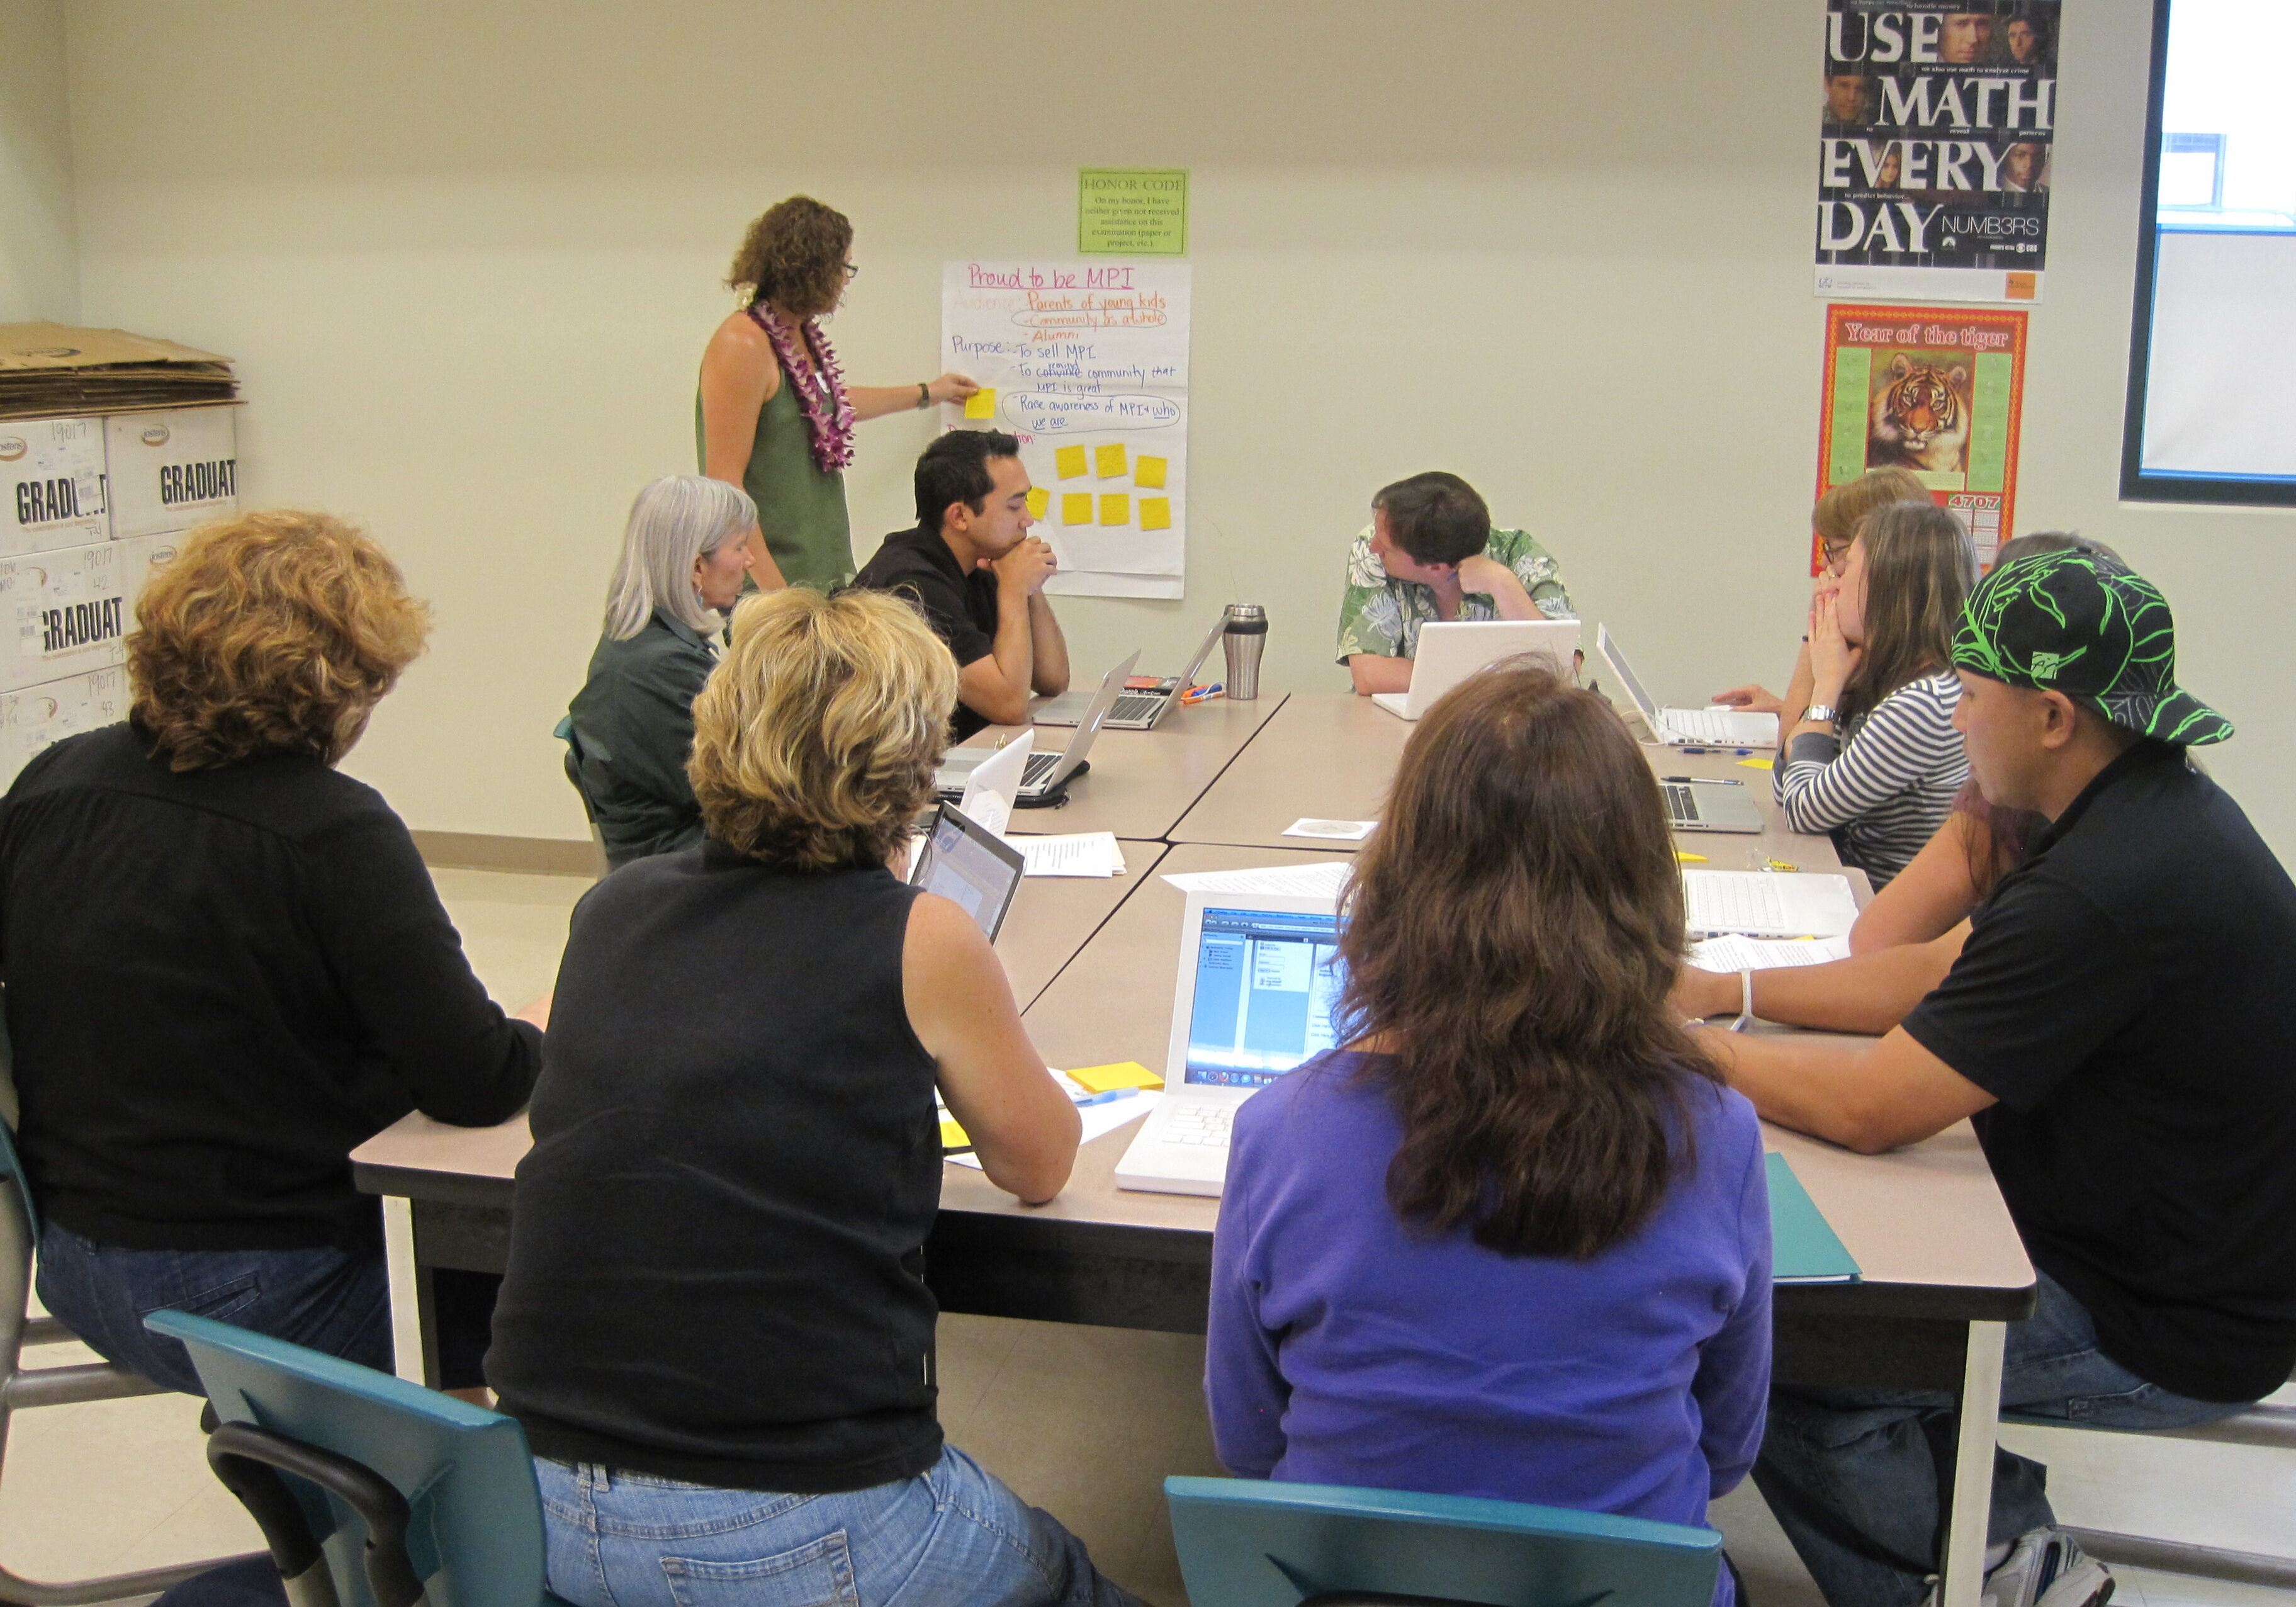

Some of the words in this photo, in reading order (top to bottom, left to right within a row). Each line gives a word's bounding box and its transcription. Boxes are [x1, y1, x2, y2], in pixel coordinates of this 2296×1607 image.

[1826, 12, 1943, 63] USE
[1875, 76, 2056, 129] MATH
[1821, 138, 2018, 191] EVERY
[1084, 179, 1138, 190] HONOR
[1144, 180, 1183, 191] CODE
[1112, 208, 1132, 217] given
[1138, 230, 1161, 238] (paper
[1818, 201, 1944, 252] DAY
[1942, 215, 2039, 236] NUMB3RS
[968, 263, 1024, 289] Proud
[1028, 267, 1044, 288] to
[1054, 269, 1076, 289] be
[1088, 268, 1135, 290] MPI
[1027, 290, 1073, 310] Parents
[1081, 293, 1095, 309] of
[1099, 297, 1134, 318] young
[1139, 290, 1167, 309] kids
[1030, 313, 1098, 331] Community
[1104, 314, 1118, 325] as
[1122, 315, 1132, 324] a
[1133, 310, 1164, 325] whole
[1032, 329, 1079, 342] Alumni
[1845, 322, 1893, 343] Year
[1896, 324, 1920, 344] of
[1924, 325, 1957, 344] the
[1961, 326, 2008, 351] tiger
[1016, 344, 1032, 358] To
[1038, 343, 1059, 358] sell
[1066, 344, 1096, 360] MPI
[1019, 363, 1032, 377] To
[1088, 364, 1145, 389] community
[1152, 366, 1176, 378] that
[1037, 383, 1057, 393] MPI
[1064, 381, 1072, 392] is
[1076, 380, 1101, 400] great
[1020, 395, 1046, 412] Raise
[1049, 401, 1099, 412] awareness
[1105, 398, 1114, 413] of
[1120, 402, 1144, 416] MPI
[1153, 401, 1176, 417] who
[52, 422, 87, 443] 19017
[144, 428, 166, 438] jostens
[1032, 418, 1046, 429] we
[1050, 417, 1069, 427] are
[160, 460, 236, 505] GRADUAT
[17, 474, 106, 525] GRADUT
[1949, 494, 2000, 509] 4707
[84, 548, 112, 570] 19017
